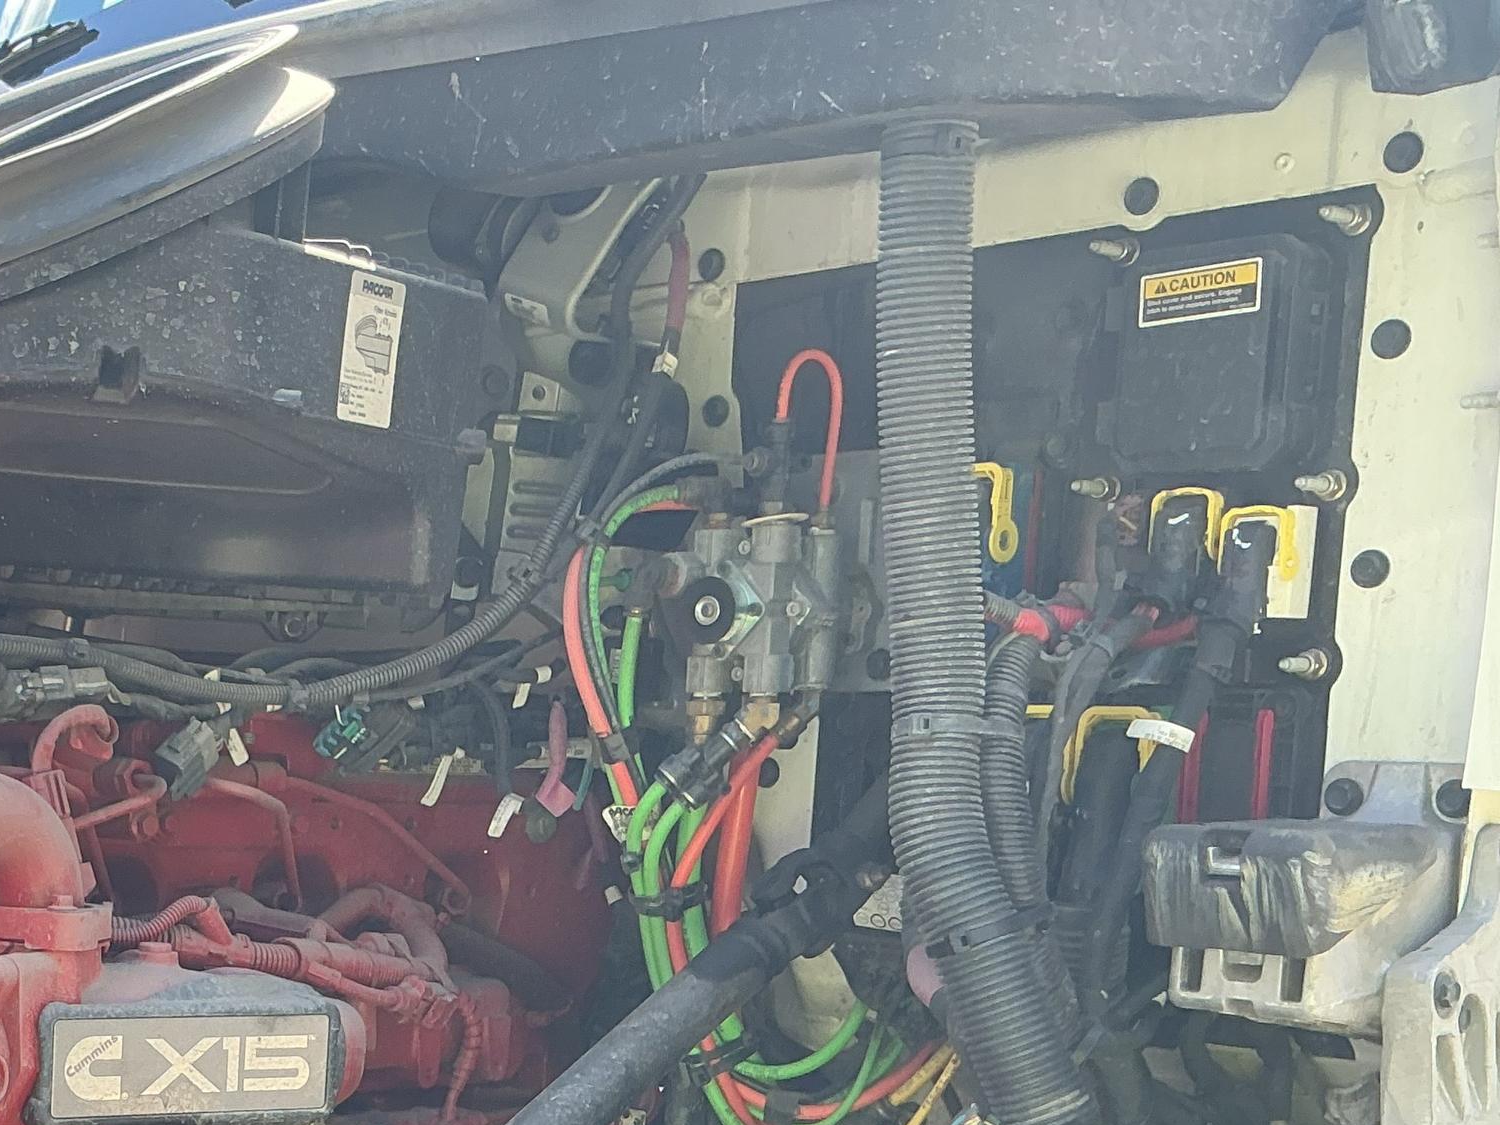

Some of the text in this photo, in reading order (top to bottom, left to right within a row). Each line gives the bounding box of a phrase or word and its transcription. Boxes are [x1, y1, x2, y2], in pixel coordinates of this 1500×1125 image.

[362, 279, 394, 300] PACCAR
[1169, 269, 1236, 292] CAUTION
[65, 1034, 311, 1097] Cummins X15
